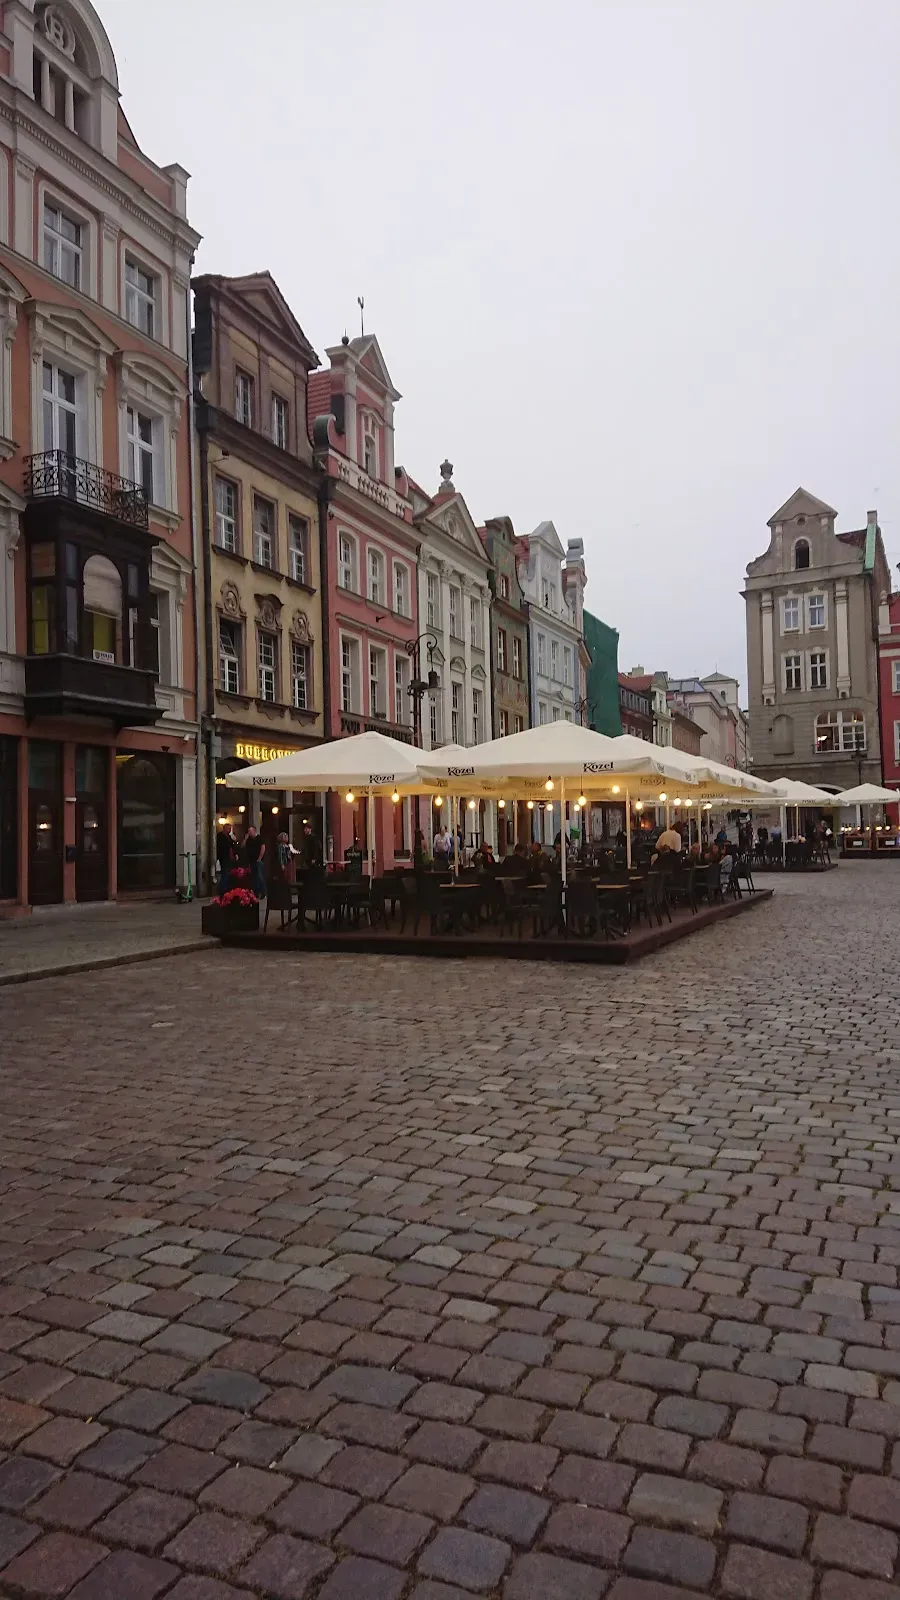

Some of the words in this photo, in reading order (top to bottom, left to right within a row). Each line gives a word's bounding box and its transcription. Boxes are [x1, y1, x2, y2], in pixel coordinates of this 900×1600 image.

[447, 767, 475, 776] Kozel
[583, 762, 614, 773] Kozel
[252, 776, 277, 786] Kozel
[369, 774, 395, 784] Kozel
